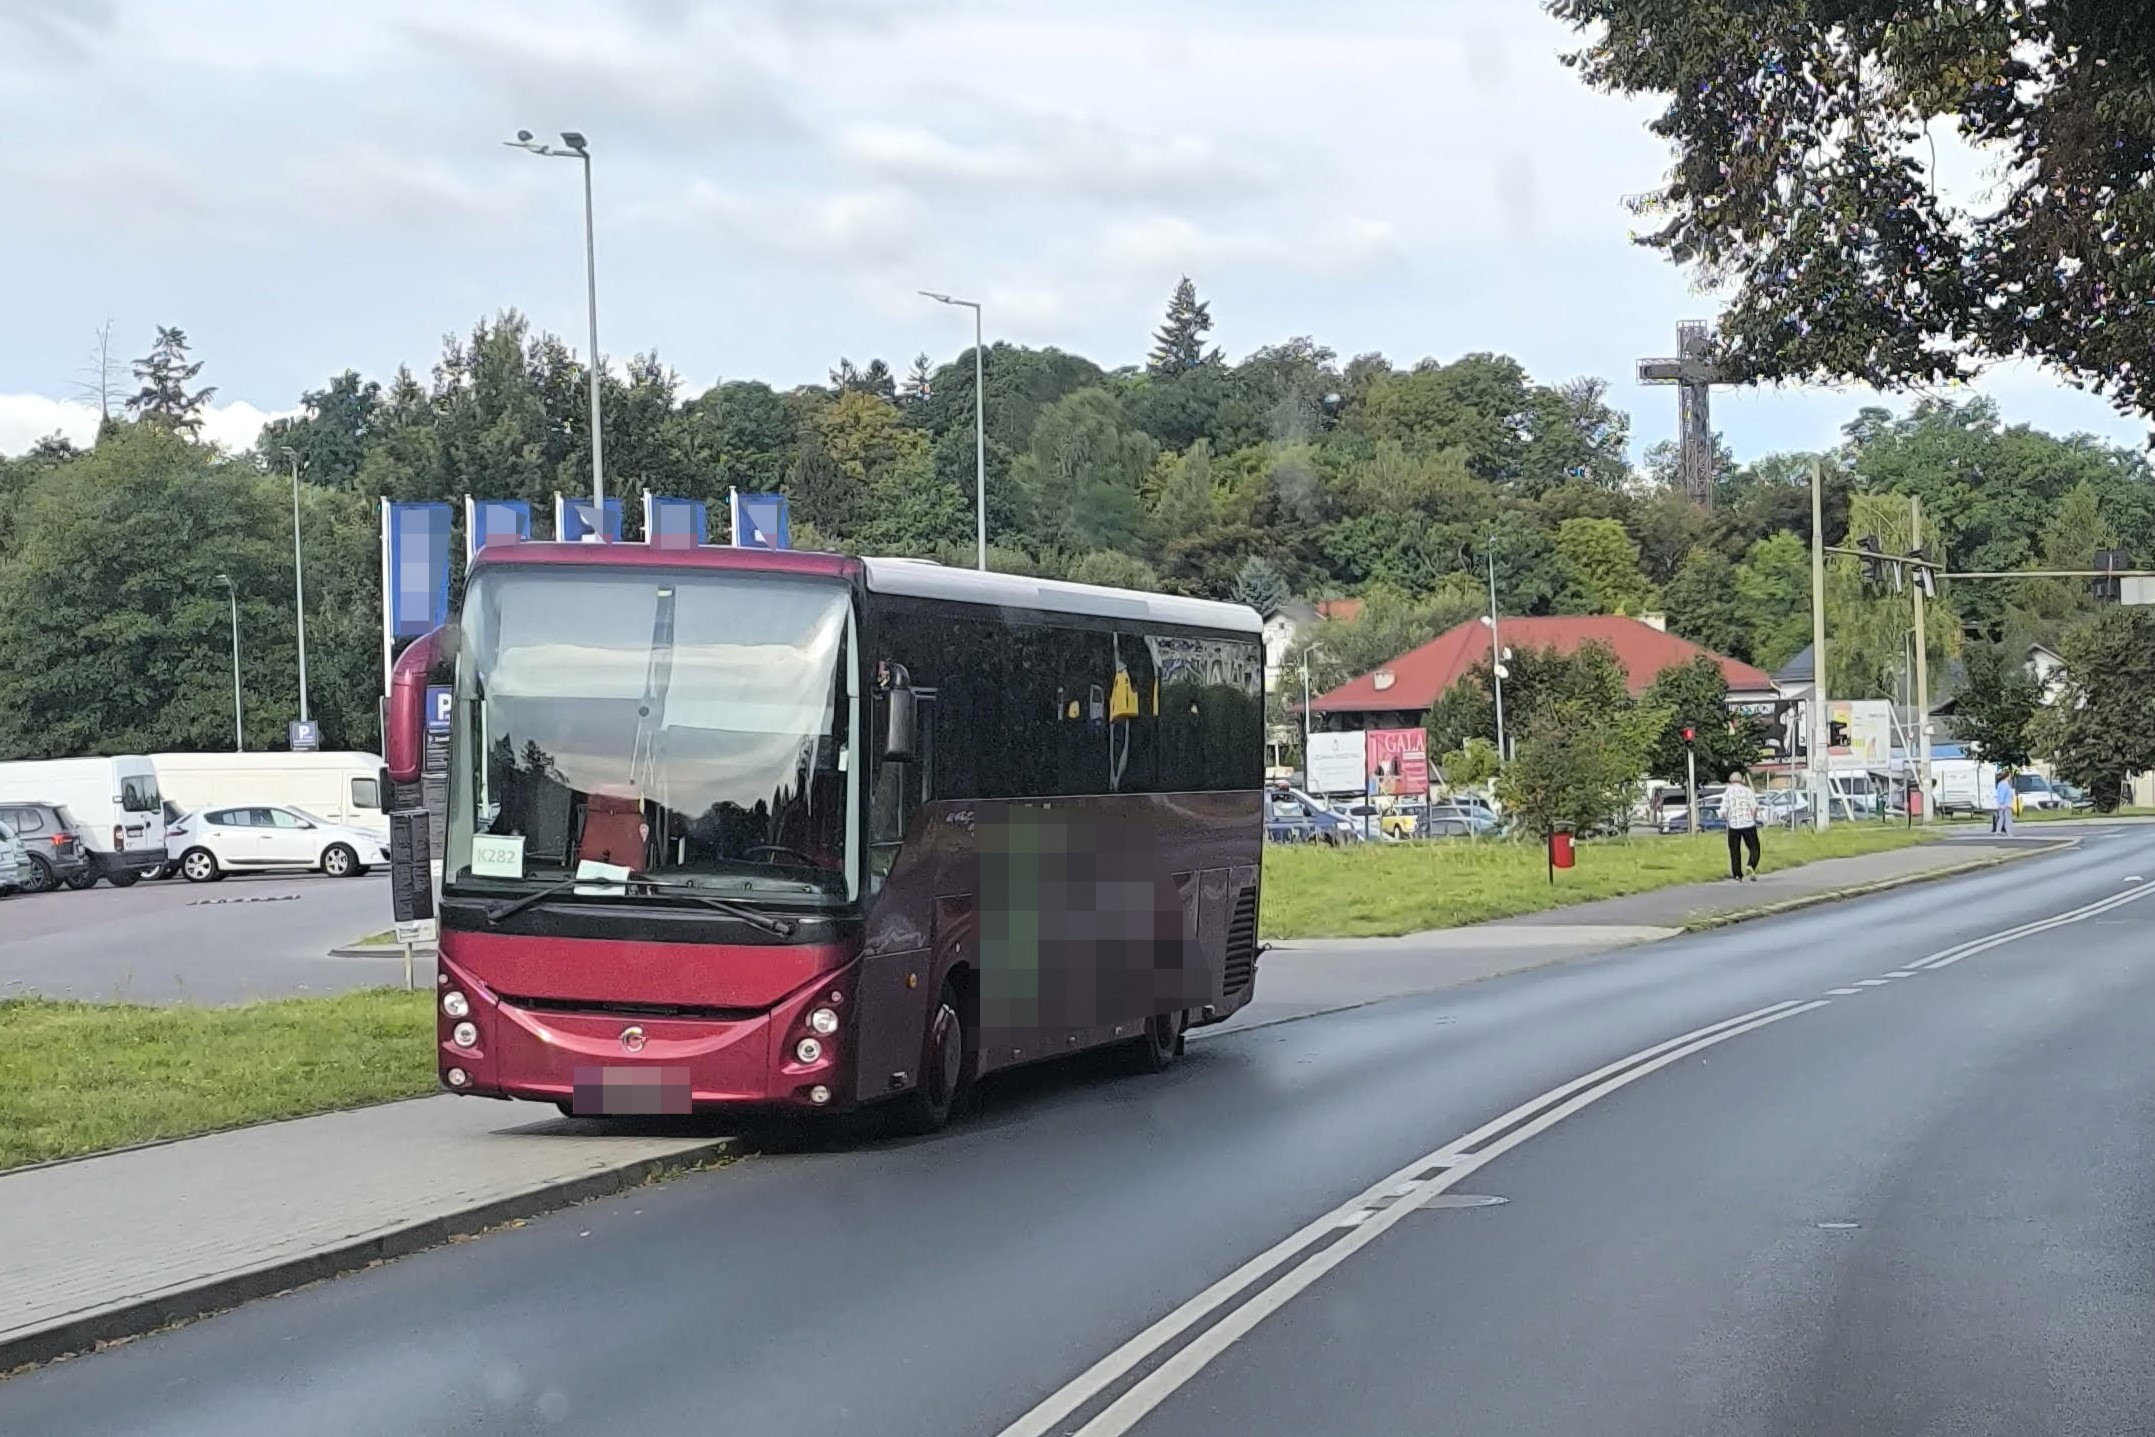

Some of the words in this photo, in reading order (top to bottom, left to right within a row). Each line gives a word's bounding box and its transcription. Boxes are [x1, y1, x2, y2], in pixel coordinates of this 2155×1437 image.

[437, 693, 452, 720] P
[298, 725, 310, 739] P
[1385, 733, 1424, 753] GALA
[478, 847, 516, 864] K282
